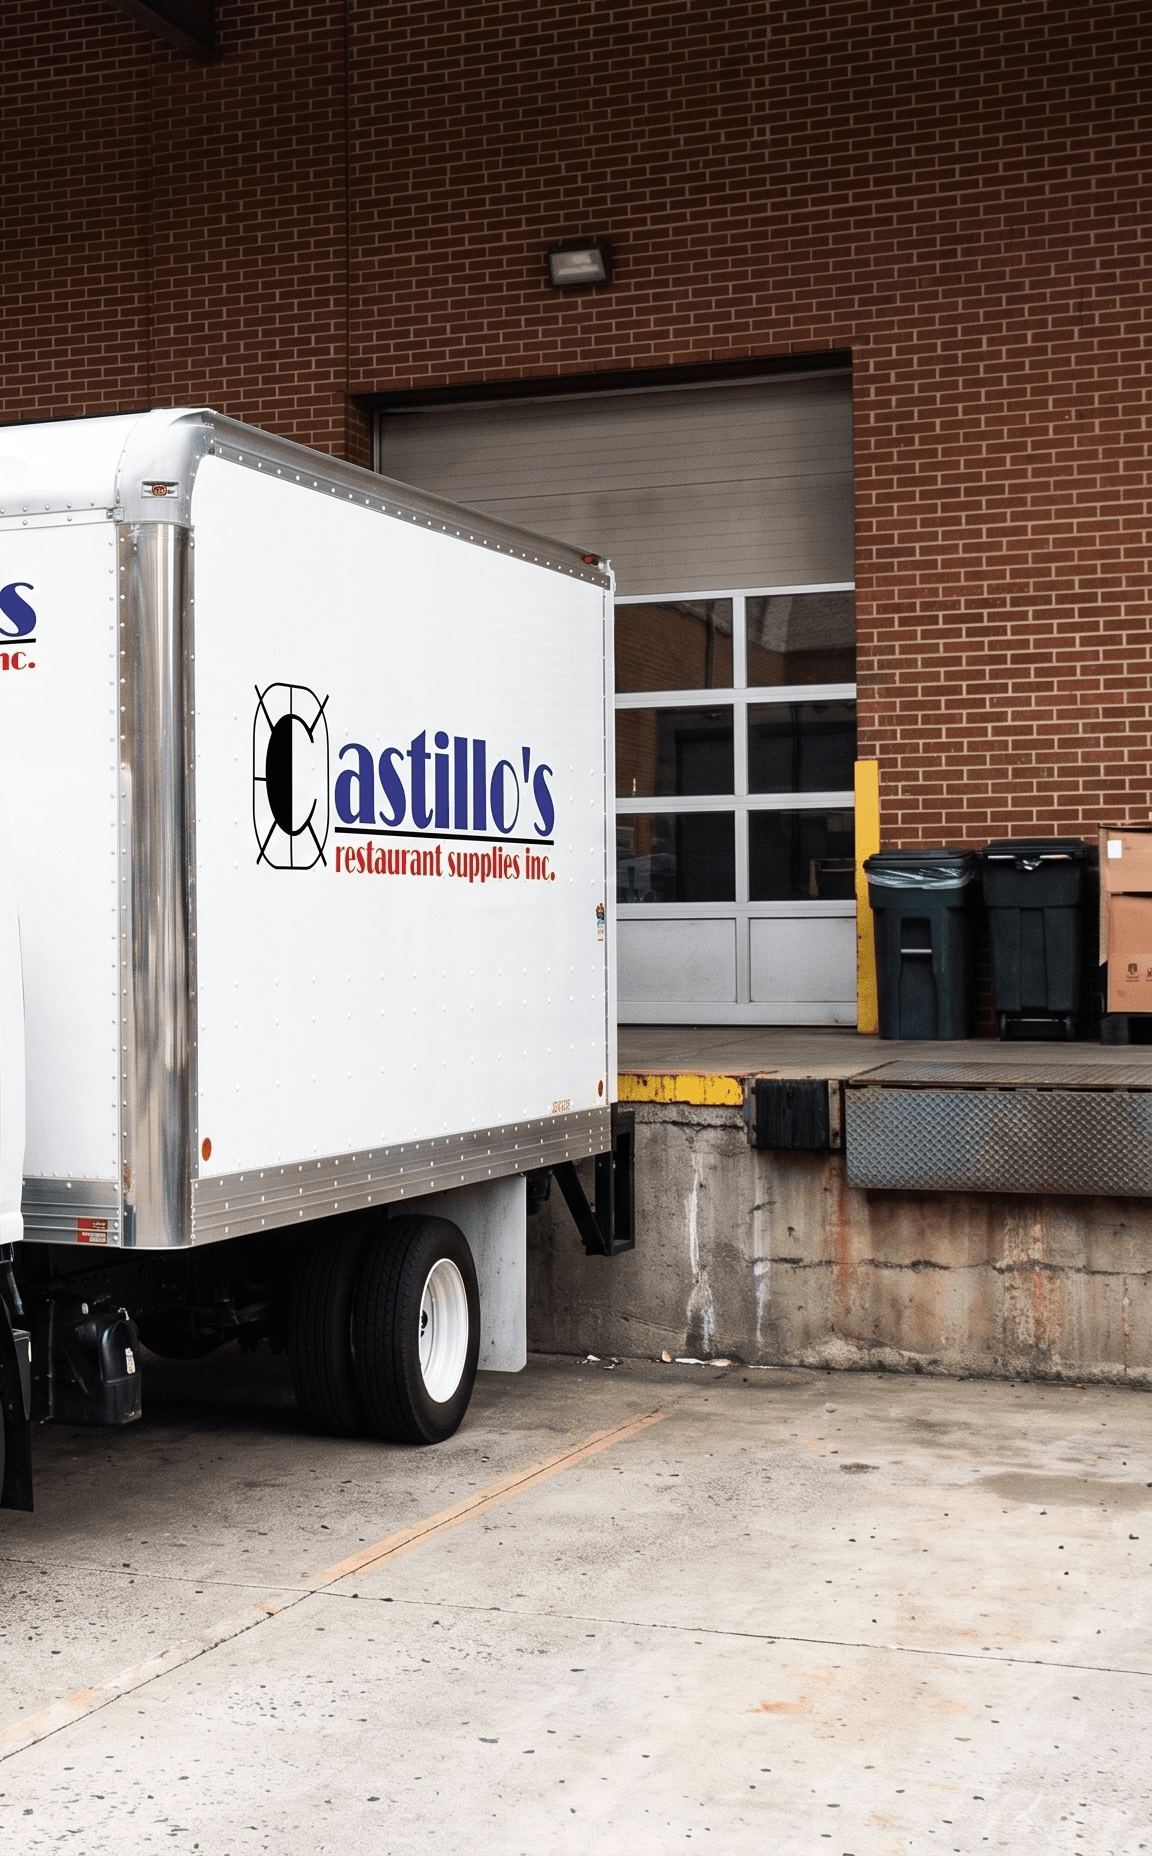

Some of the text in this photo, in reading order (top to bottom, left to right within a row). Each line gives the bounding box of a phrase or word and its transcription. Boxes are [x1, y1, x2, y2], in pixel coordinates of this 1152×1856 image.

[265, 713, 555, 837] Castillo's
[334, 840, 556, 882] restaurant supplies inc.
